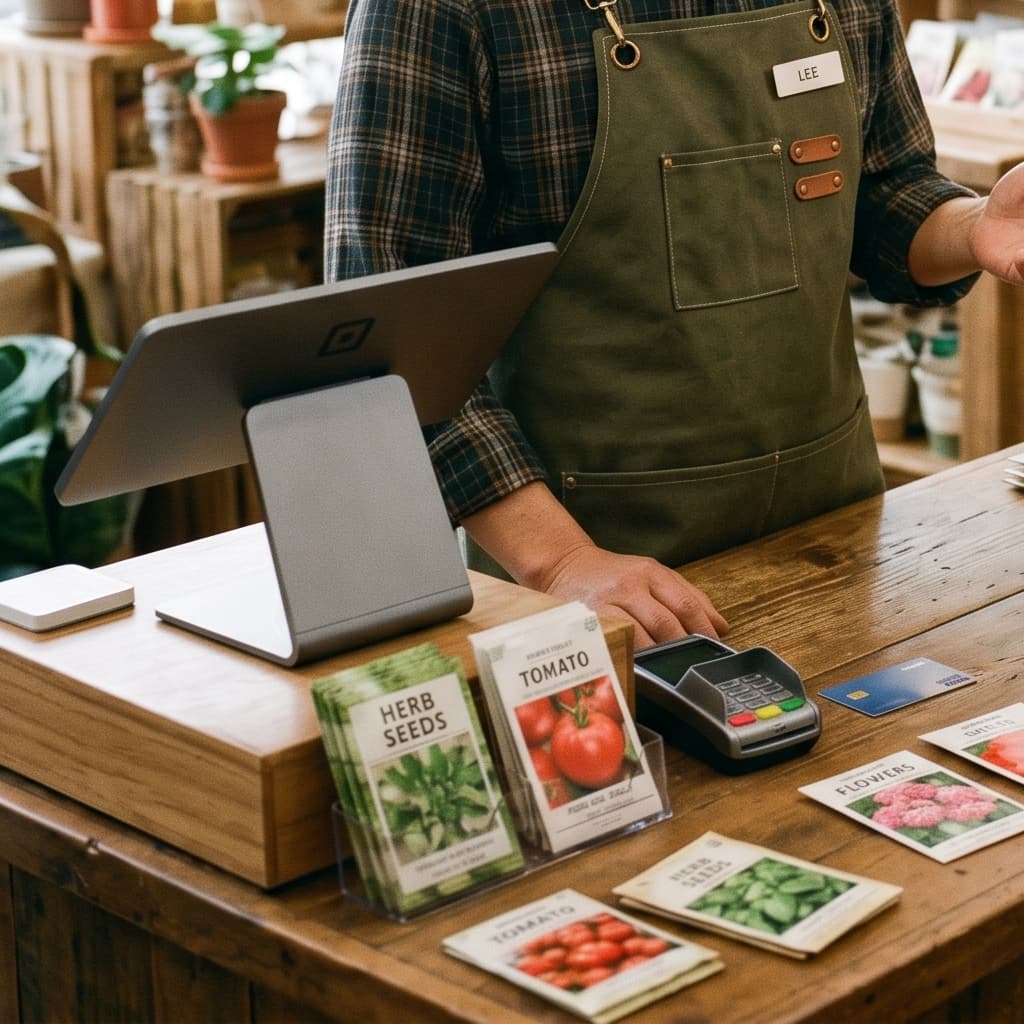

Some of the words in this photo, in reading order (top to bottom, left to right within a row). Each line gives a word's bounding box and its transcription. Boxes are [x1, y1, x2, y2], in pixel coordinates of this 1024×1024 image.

[798, 66, 819, 82] LEE
[518, 651, 589, 688] TOMATO
[380, 692, 435, 724] HERB
[383, 711, 447, 748] SEEDS
[835, 763, 916, 796] FLOWERS
[488, 905, 576, 944] TOMATO
